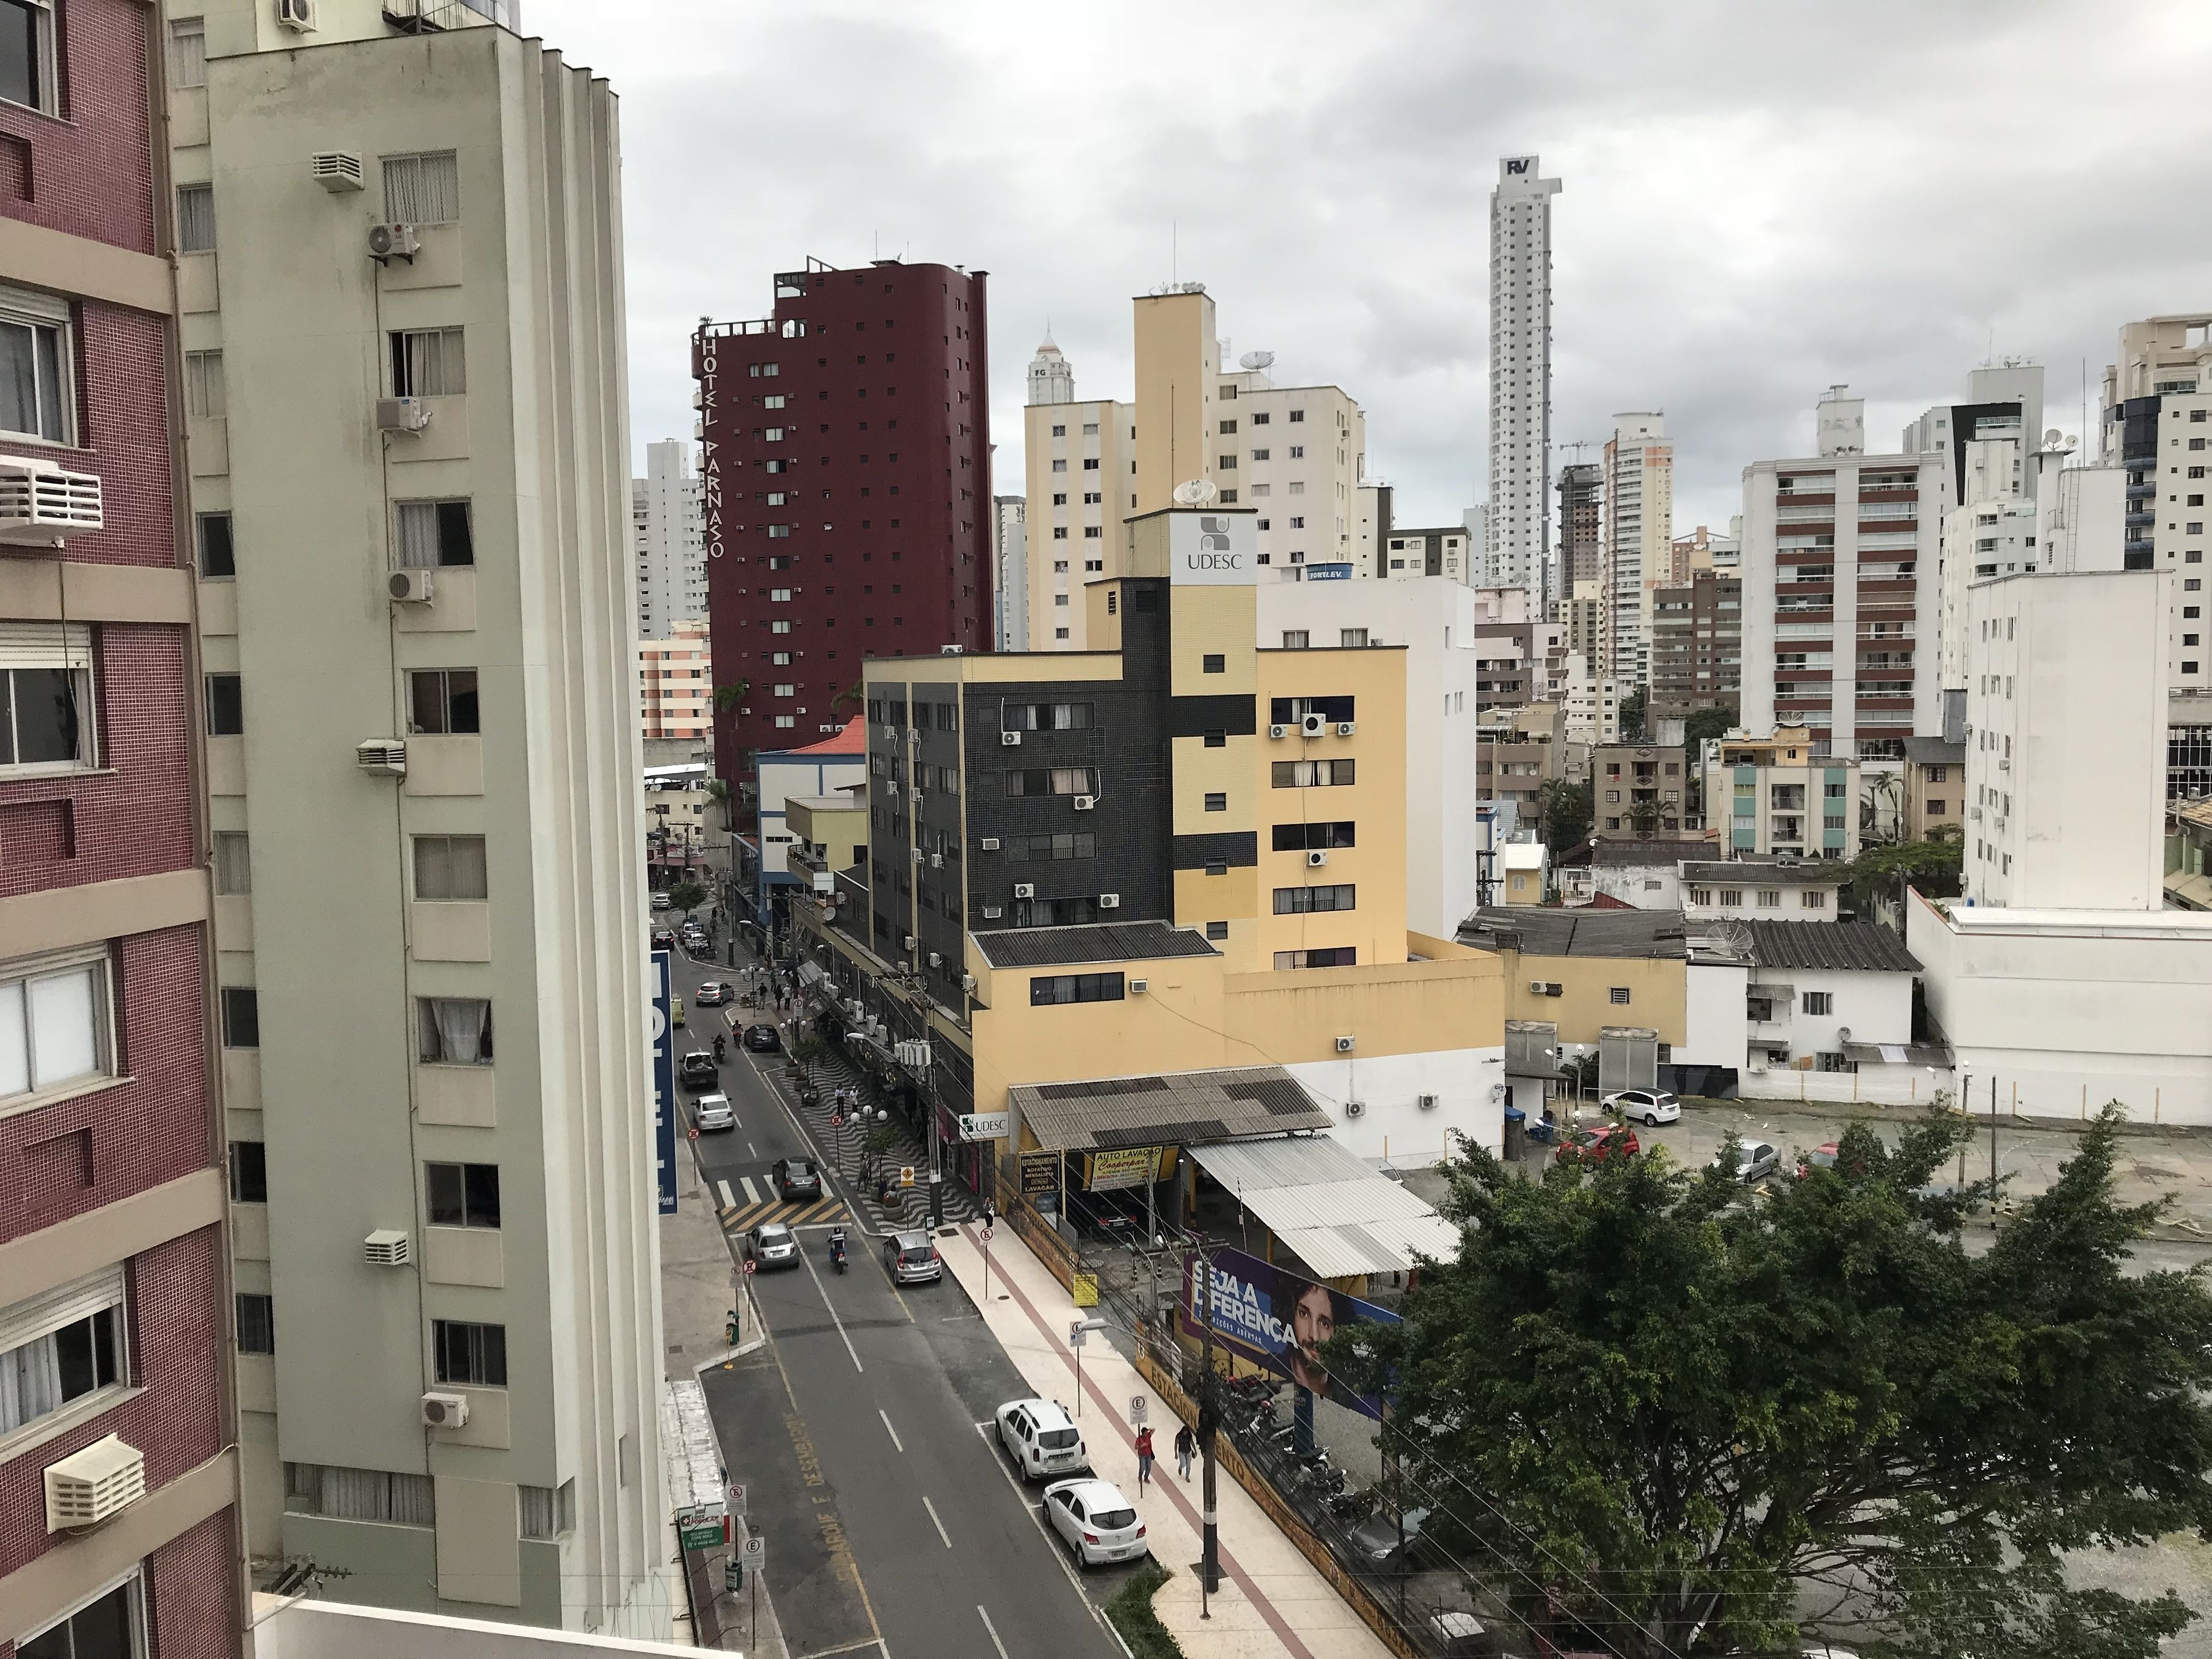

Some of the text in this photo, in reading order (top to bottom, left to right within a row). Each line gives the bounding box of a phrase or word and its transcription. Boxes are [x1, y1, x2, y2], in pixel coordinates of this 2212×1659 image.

[702, 339, 724, 558] HOTEL PARNASO
[1188, 554, 1242, 569] UDESC
[976, 1119, 1006, 1132] UDESC
[1097, 1152, 1120, 1161] AUTO
[1243, 1282, 1259, 1309] A
[1194, 1282, 1299, 1350] DFERENÇA
[1237, 1327, 1263, 1345] ABERTAS
